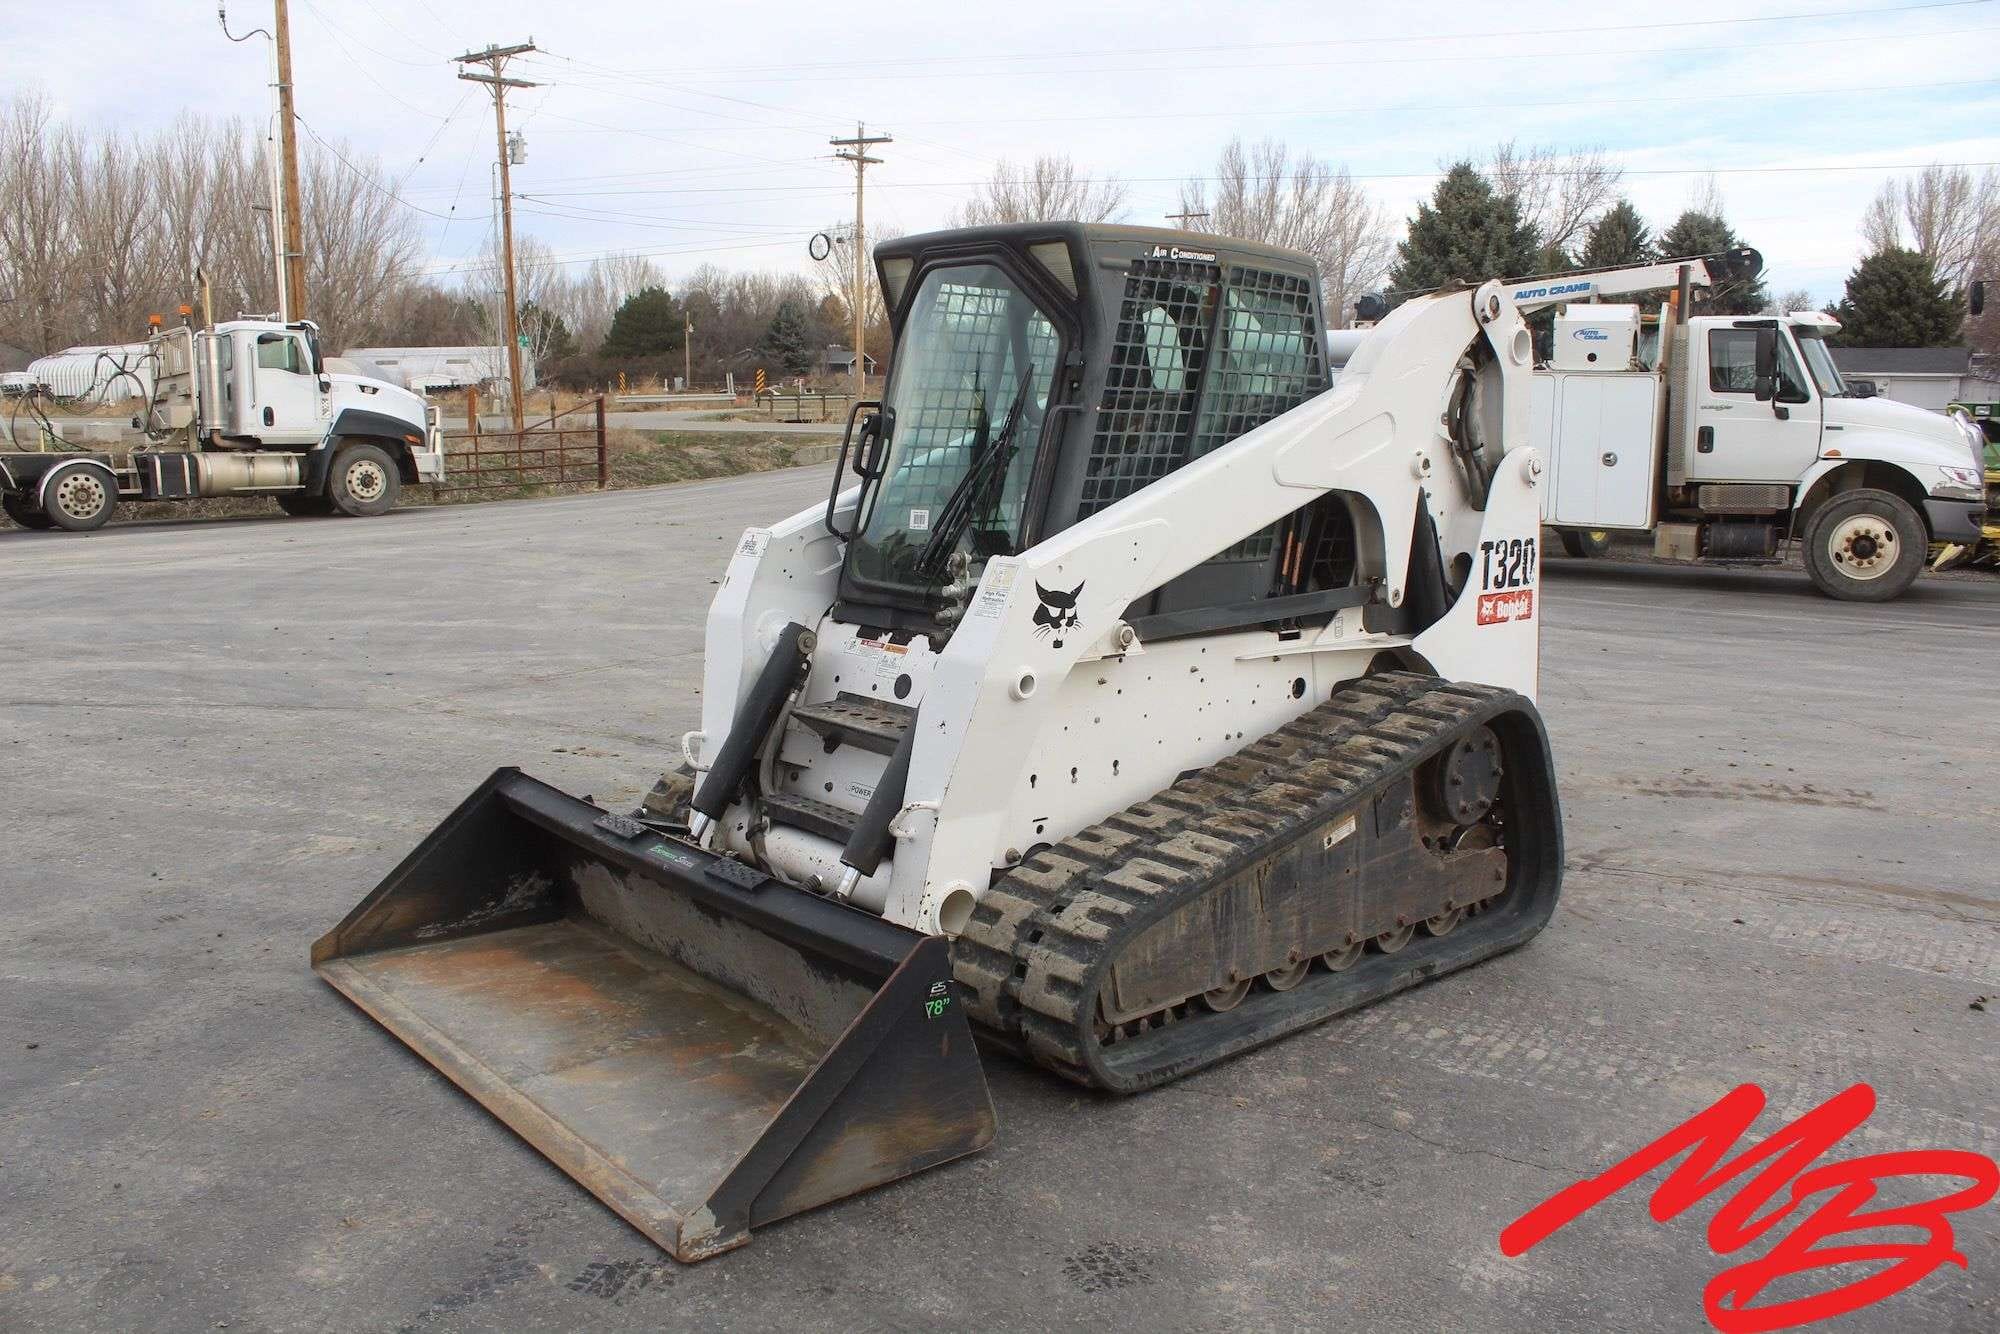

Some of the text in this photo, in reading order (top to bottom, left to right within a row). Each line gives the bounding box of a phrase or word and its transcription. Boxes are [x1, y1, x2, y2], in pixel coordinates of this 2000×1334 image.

[1514, 282, 1591, 300] AUTO CRANE
[1481, 537, 1535, 590] T320
